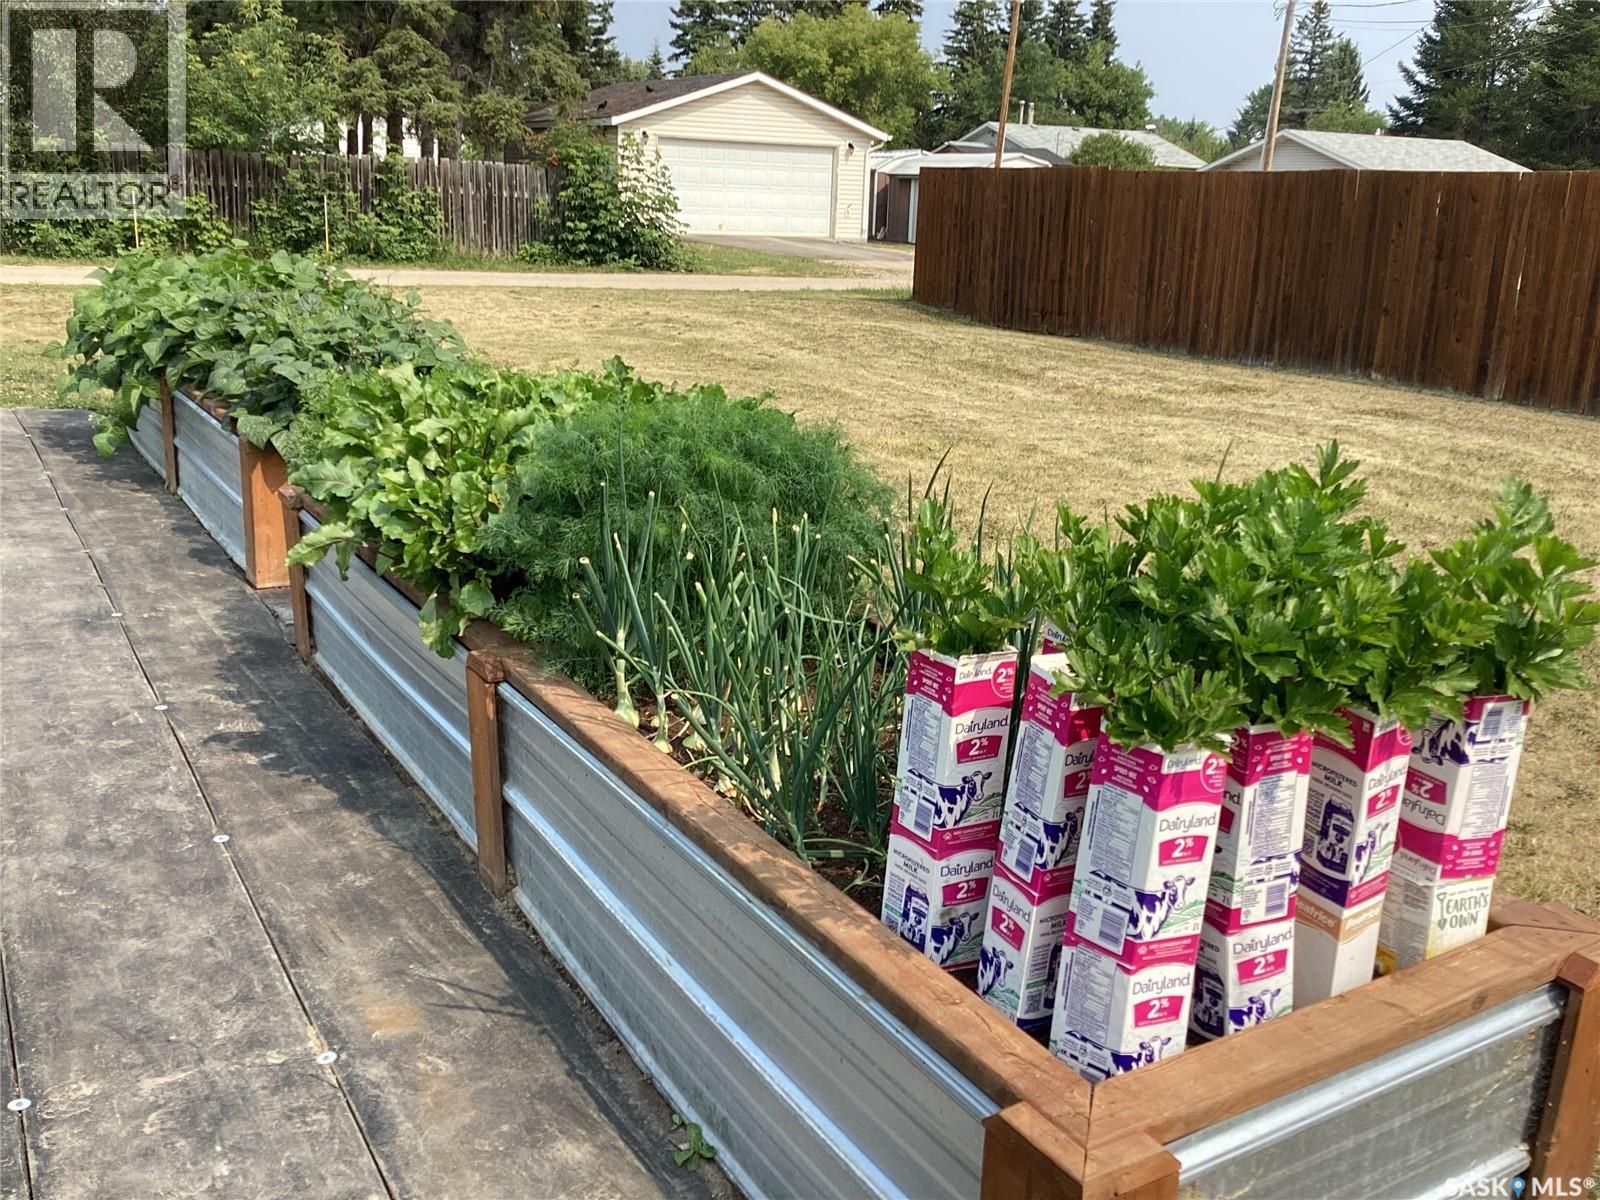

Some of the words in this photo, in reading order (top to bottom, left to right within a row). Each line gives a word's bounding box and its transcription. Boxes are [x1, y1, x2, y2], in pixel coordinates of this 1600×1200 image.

[955, 714, 1009, 735] Dairyland
[968, 737, 989, 756] 2%
[1410, 780, 1435, 799] 2%
[1158, 812, 1217, 833] Dairyland
[1171, 837, 1194, 858] 2%
[940, 856, 994, 878] Dairyland
[956, 879, 977, 899] 2%
[992, 883, 1031, 925] Dairyland
[1445, 892, 1490, 915] EARTH'S
[999, 913, 1015, 934] 2%
[1449, 911, 1480, 929] OWN
[1232, 930, 1294, 955] Dairyland
[1253, 954, 1275, 976] 2%
[1132, 973, 1191, 996] Dairyland
[1147, 998, 1170, 1020] 2%
